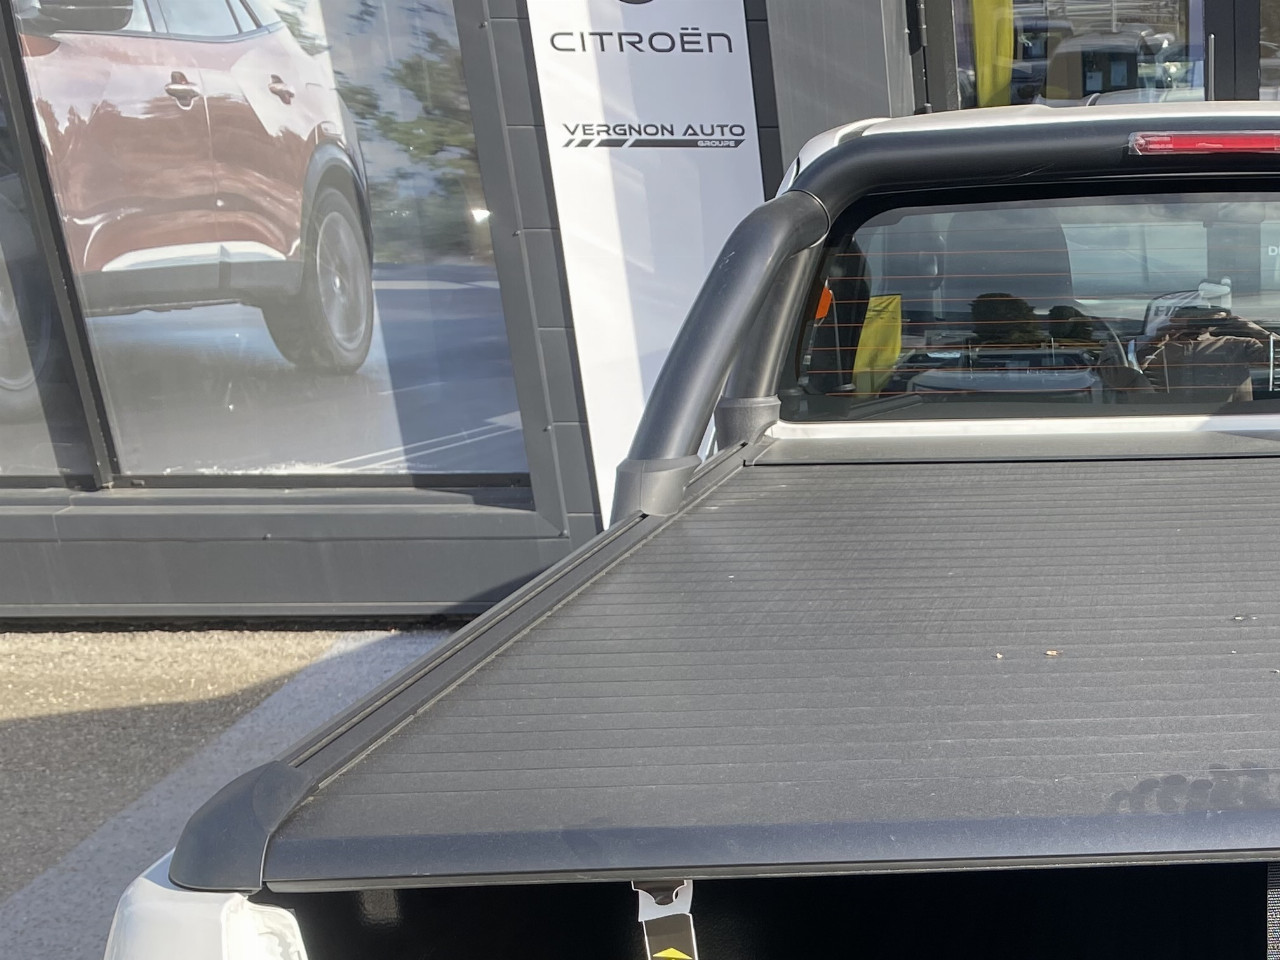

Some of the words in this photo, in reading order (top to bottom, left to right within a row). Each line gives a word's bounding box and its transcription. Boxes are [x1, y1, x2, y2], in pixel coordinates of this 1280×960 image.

[550, 27, 733, 53] CITROËN
[562, 123, 675, 137] VERGNON
[682, 123, 746, 137] AUTO
